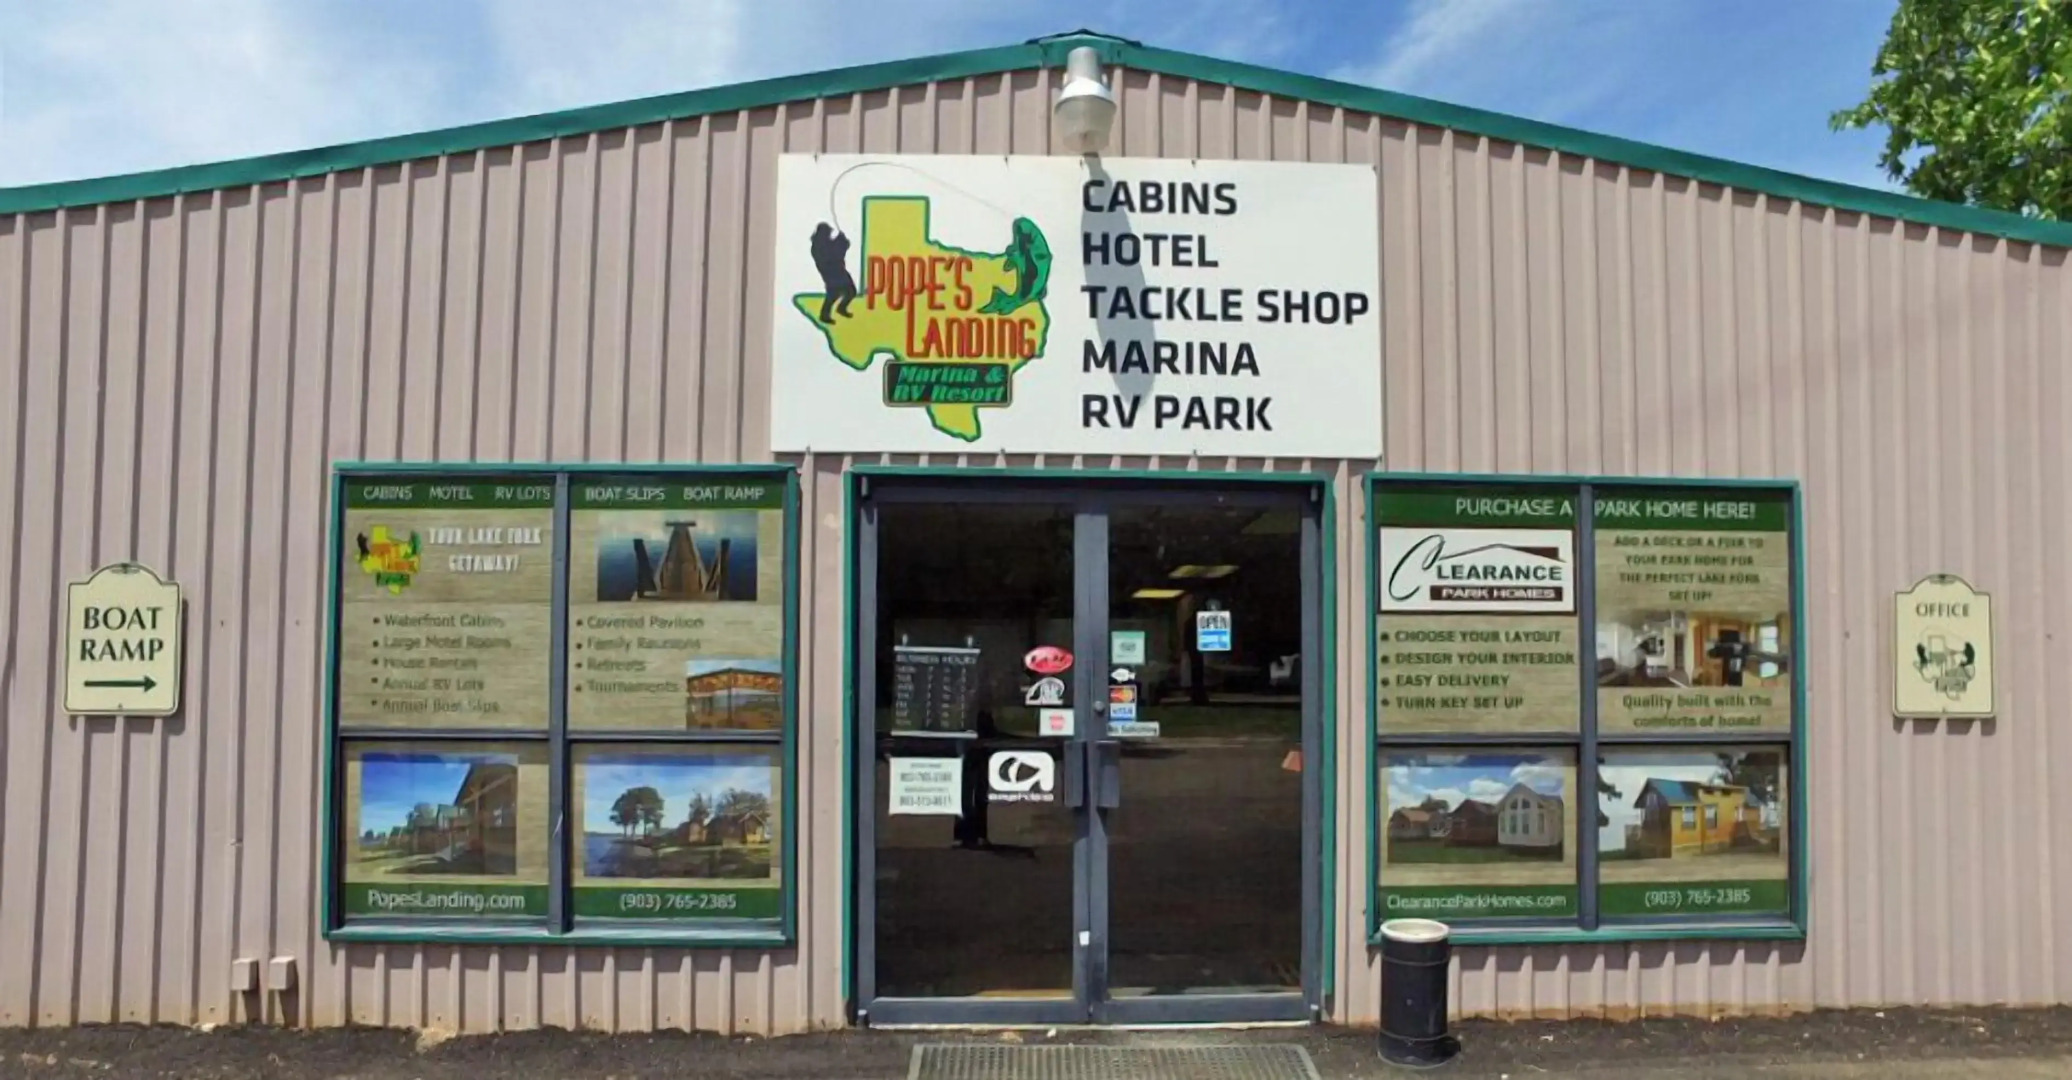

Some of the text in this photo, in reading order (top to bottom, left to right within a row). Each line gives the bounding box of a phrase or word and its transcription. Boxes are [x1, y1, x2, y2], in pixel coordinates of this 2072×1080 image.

[1082, 180, 1238, 216] CABINS
[1082, 231, 1219, 268] HOTEL
[867, 255, 973, 311] POPE'S
[1080, 285, 1369, 325] TACKLE SHOP
[1082, 339, 1261, 377] MARINA
[899, 365, 1005, 383] Marina &
[893, 384, 1005, 401] RV Resort
[1082, 393, 1273, 431] RV PARK
[363, 485, 551, 500] CABINS MOTEL RV LOTS
[585, 486, 765, 501] BOAT SLIPS BOAT RAMP
[1455, 497, 1757, 519] PURCHASE A PARK HOME HERE!
[1642, 536, 1650, 547] A
[1706, 537, 1715, 548] A
[1388, 533, 1563, 601] CLEARANCE
[1626, 555, 1657, 566] YOUR
[1694, 555, 1728, 566] HOME
[1619, 573, 1641, 584] THE
[1645, 573, 1695, 584] PERFECT
[1441, 587, 1556, 599] PARK HOMES
[1915, 602, 1970, 618] OFFICE
[83, 606, 164, 631] BOAT
[384, 614, 506, 628] Waterfront Cabins
[587, 615, 705, 629] Covered Pavilion
[1199, 614, 1229, 630] OPEN
[383, 636, 421, 651] Large
[425, 636, 462, 648] Motel
[587, 637, 633, 652] Family
[1395, 630, 1561, 643] CHOOSE YOUR LAYOUT
[80, 638, 164, 662] RAMP
[383, 656, 425, 669] House
[1395, 652, 1576, 665] DESIGN YOUR INTERIOR
[382, 678, 428, 691] Annual
[432, 678, 452, 691] RV
[587, 679, 680, 694] Tournaments
[1396, 674, 1511, 687] EASY DELIVERY
[382, 699, 428, 713] Annual
[1396, 696, 1525, 710] TURN KEY SET UP
[1622, 694, 1773, 711] Quality built with the
[368, 889, 526, 913] PopesLanding.com
[620, 893, 737, 912] (903) 765-2385
[1386, 892, 1567, 910] ClearanceParkHomes.com
[1644, 888, 1751, 909] (903) 765-2385
